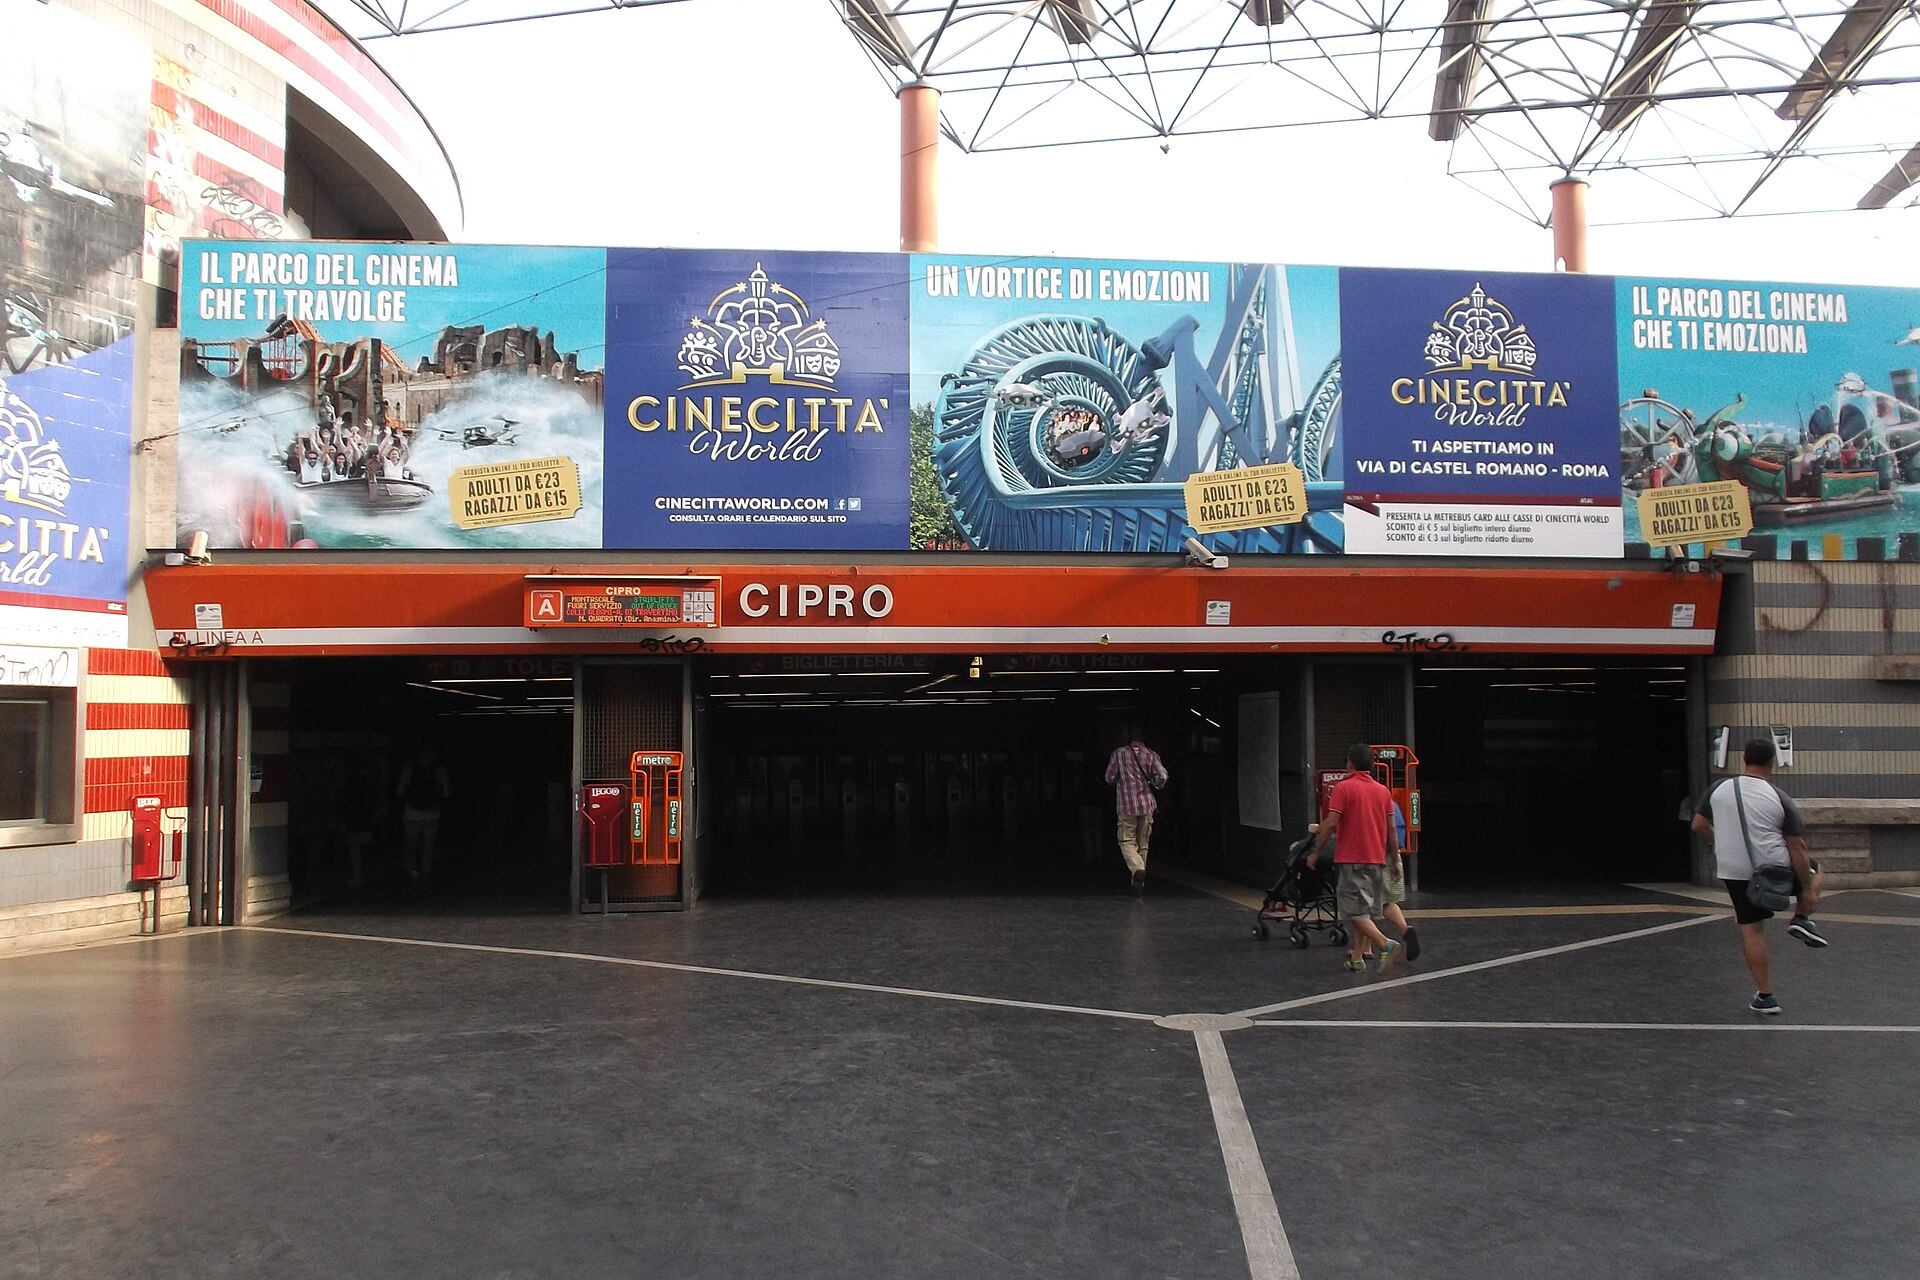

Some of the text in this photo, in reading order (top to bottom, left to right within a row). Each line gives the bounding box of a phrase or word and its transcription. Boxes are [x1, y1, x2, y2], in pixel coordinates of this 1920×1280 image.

[200, 251, 458, 287] IL PARCO DEL CINEMA
[926, 264, 1210, 302] UN VORTICE DI EMOZIONI
[199, 288, 407, 322] CHE TI TRAVOLGE
[1632, 286, 1848, 322] IL PARCO DEL CINEMA
[1633, 319, 1808, 354] CHE TI EMOZIONA
[1435, 397, 1530, 427] World
[689, 421, 829, 461] World
[1412, 440, 1554, 455] TI ASPETTIAMO IN
[1356, 460, 1385, 473] VIA
[1389, 461, 1406, 474] DI
[1410, 461, 1472, 475] CASTEL
[1476, 462, 1547, 476] ROMANO
[1562, 464, 1609, 478] ROMA
[468, 471, 560, 497] ADULTI DA €23
[1203, 478, 1288, 503] ADULTI DA €23
[525, 492, 541, 510] DA
[544, 489, 568, 507] €15
[655, 497, 829, 511] CINECITTAWORLD.COM
[1256, 498, 1272, 515] DA
[1273, 495, 1295, 513] €15
[1655, 494, 1734, 518] ADULTI DA €23
[669, 514, 716, 522] CONSULTA
[717, 514, 744, 522] ORARI
[752, 515, 808, 523] CALENDARIO
[809, 515, 826, 523] SUL
[827, 515, 847, 523] SITO
[1386, 512, 1421, 521] PRESENTA
[1424, 513, 1432, 521] LA
[1434, 513, 1471, 521] METREBUS
[1473, 513, 1493, 521] CARD
[1494, 514, 1510, 522] ALLE
[1513, 514, 1533, 522] CASSE
[1535, 514, 1543, 522] DI
[1583, 515, 1609, 523] WORLD
[1704, 513, 1719, 530] DA
[1721, 511, 1741, 528] €15
[1386, 522, 1415, 531] SCONTO
[1418, 523, 1425, 531] di
[1440, 523, 1451, 531] sul
[1453, 523, 1482, 534] biglietto
[1485, 524, 1506, 532] intero
[1508, 525, 1531, 533] diurno
[1386, 533, 1416, 541] SCONTO
[1418, 533, 1425, 541] di
[1440, 534, 1451, 542] sul
[1453, 534, 1483, 544] biglietto
[1485, 534, 1509, 543] ridotto
[1511, 535, 1534, 543] diurno
[605, 587, 641, 596] CIPRO
[739, 583, 894, 618] CIPRO
[538, 598, 555, 616] A
[196, 631, 264, 645] LINEA A
[782, 654, 904, 669] BIGLIETTERIA
[642, 755, 672, 766] metro
[592, 787, 620, 796] LEGGO
[669, 800, 679, 835] metro
[1411, 792, 1419, 825] metro
[632, 802, 642, 837] metro
